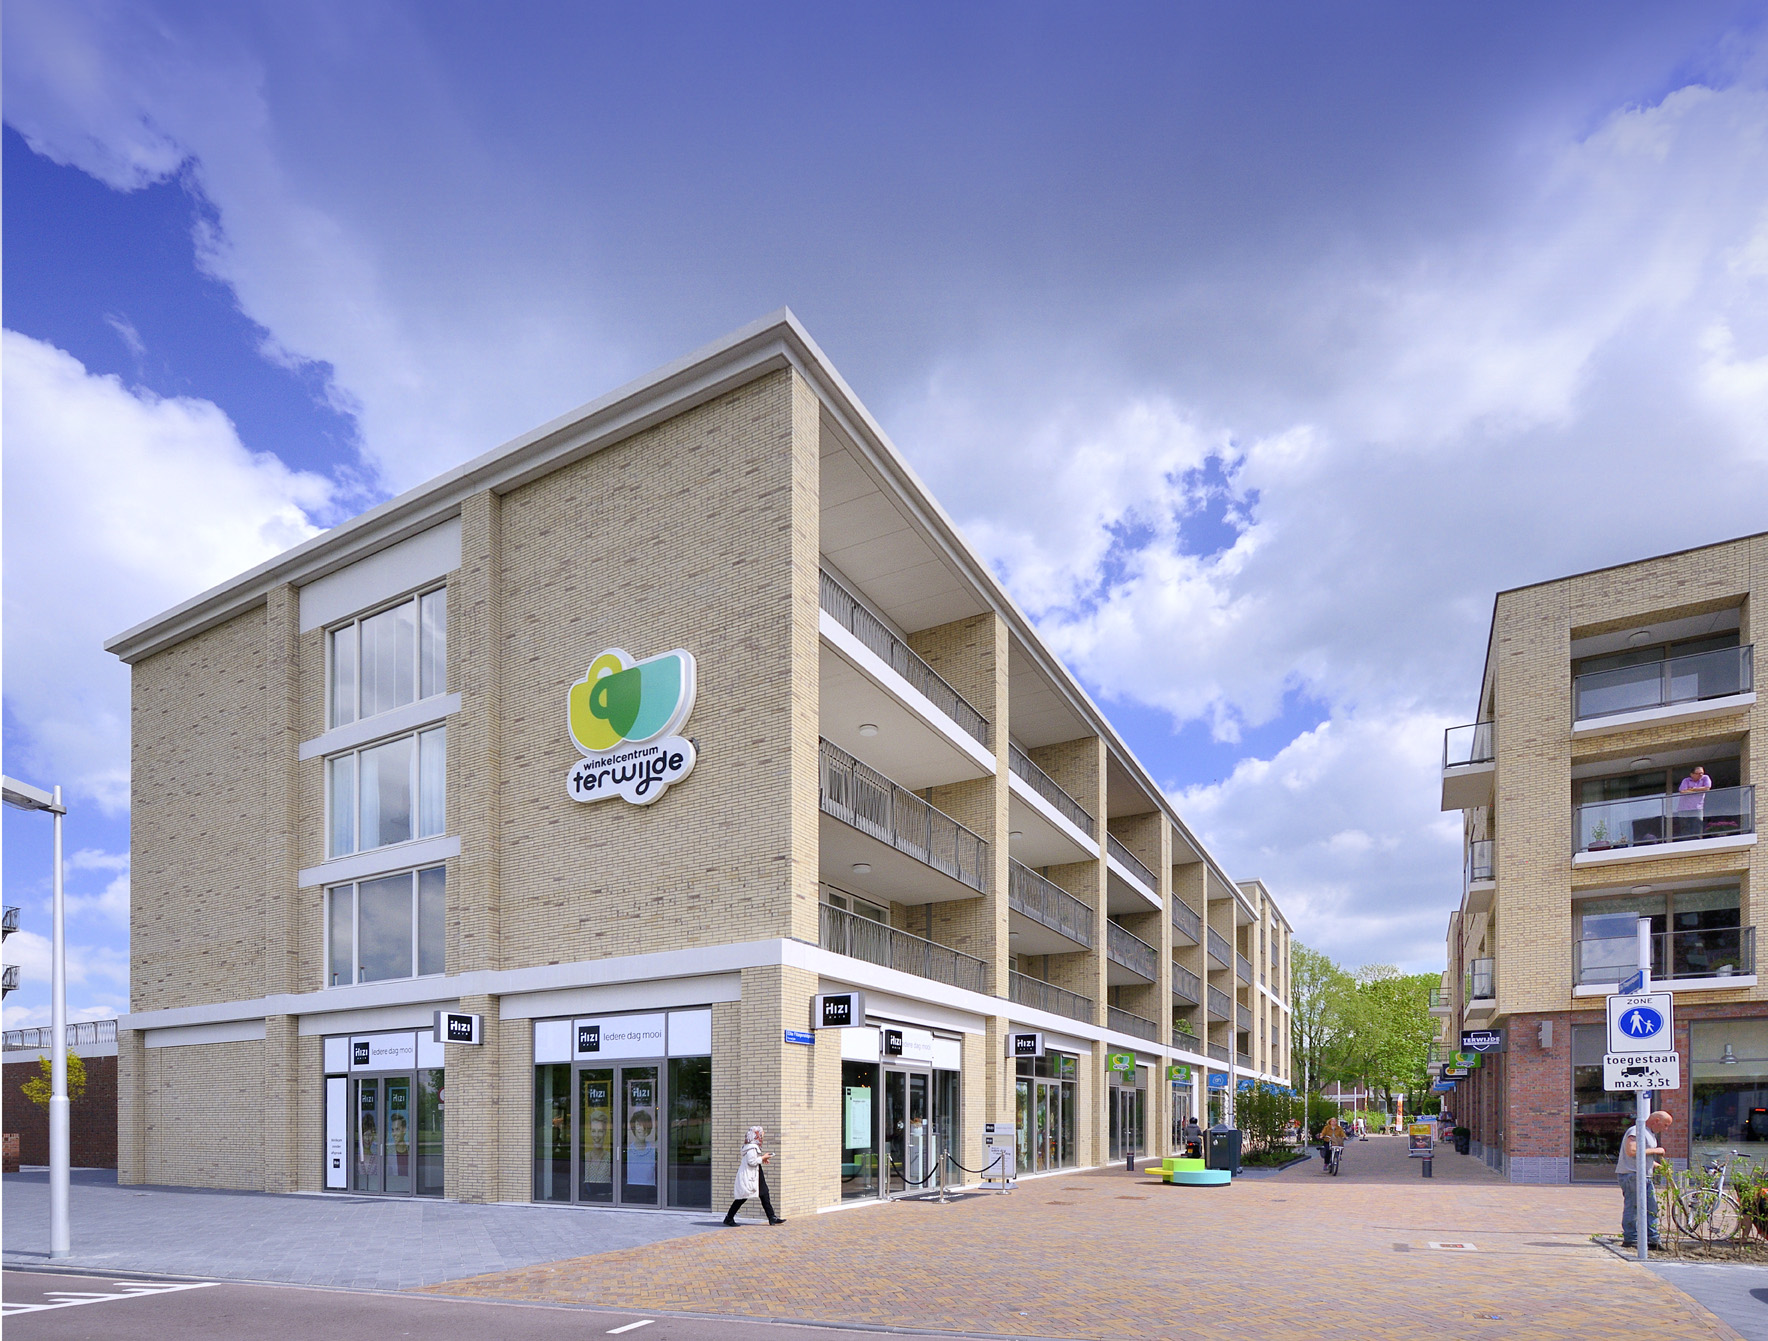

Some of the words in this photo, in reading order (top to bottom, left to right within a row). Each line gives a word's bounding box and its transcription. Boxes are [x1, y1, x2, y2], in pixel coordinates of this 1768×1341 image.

[583, 746, 659, 771] winkelcentrum
[573, 750, 684, 796] terwijde
[603, 1032, 626, 1041] Iedere
[626, 1032, 641, 1042] dag
[642, 1030, 662, 1039] mooi
[388, 1047, 399, 1056] dag
[399, 1046, 414, 1054] mooi
[1607, 1055, 1676, 1066] toegestaan
[1614, 1080, 1643, 1088] max.
